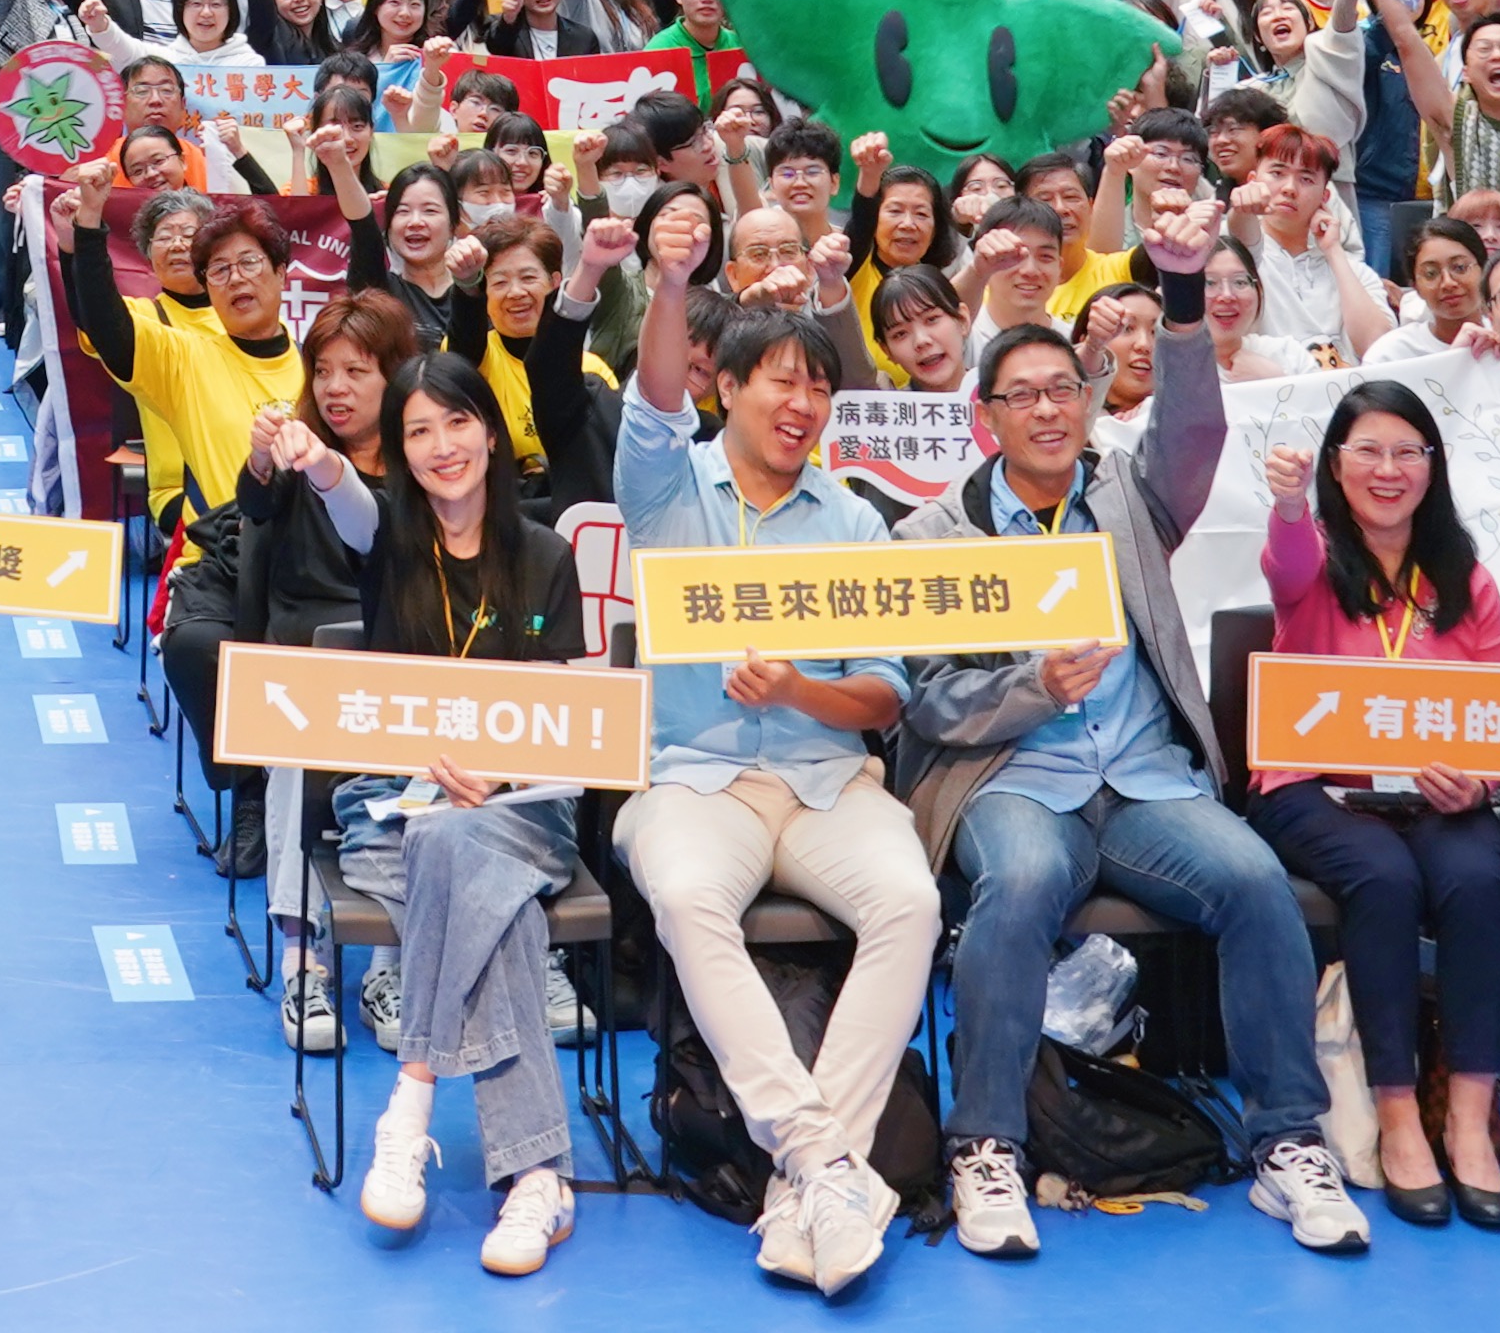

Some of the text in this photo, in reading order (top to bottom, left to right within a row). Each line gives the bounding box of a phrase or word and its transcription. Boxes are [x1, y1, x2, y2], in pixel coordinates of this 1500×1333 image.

[184, 72, 311, 102] 北醫學大
[836, 401, 974, 427] 病毒測不到
[839, 435, 974, 462] 愛滋傳不了
[683, 572, 1011, 625] 我是來做好事的
